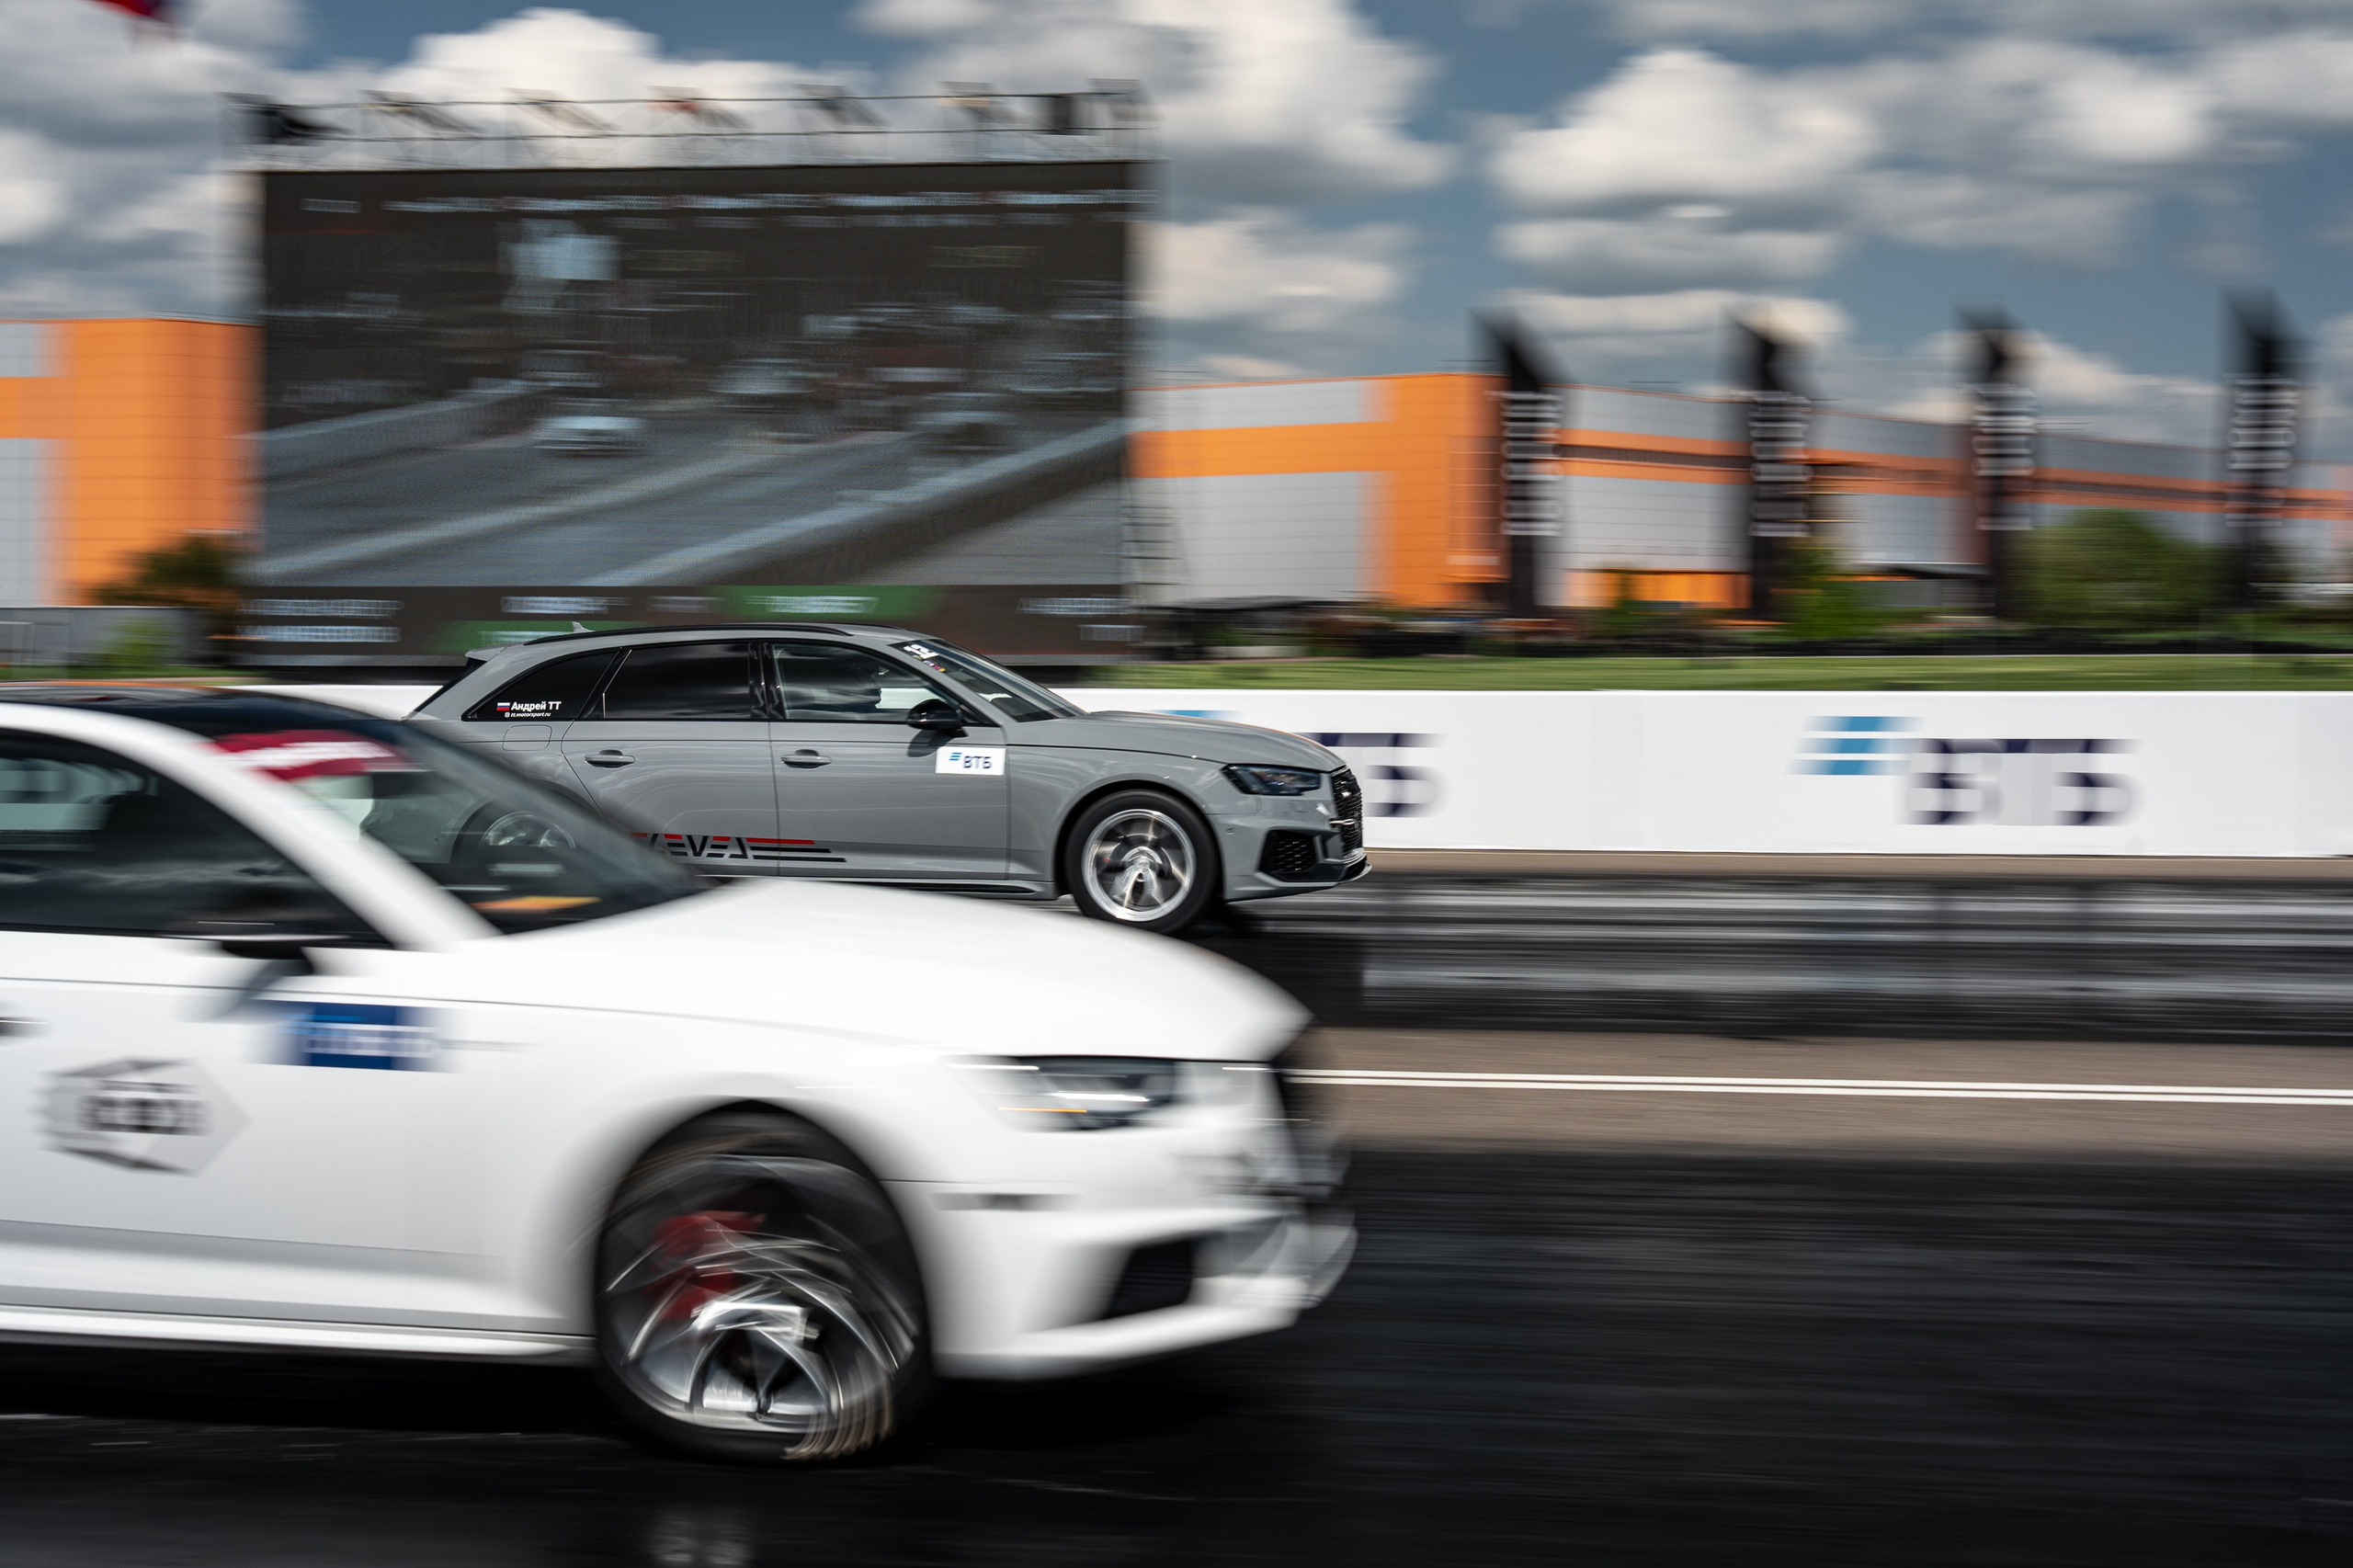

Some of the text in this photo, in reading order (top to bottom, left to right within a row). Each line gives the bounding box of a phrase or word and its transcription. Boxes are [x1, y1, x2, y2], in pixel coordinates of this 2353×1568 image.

[511, 701, 546, 712] Андрей
[964, 756, 992, 768] ВТБ
[1303, 732, 1448, 818] ТБ
[1904, 738, 2142, 826] ВТБ
